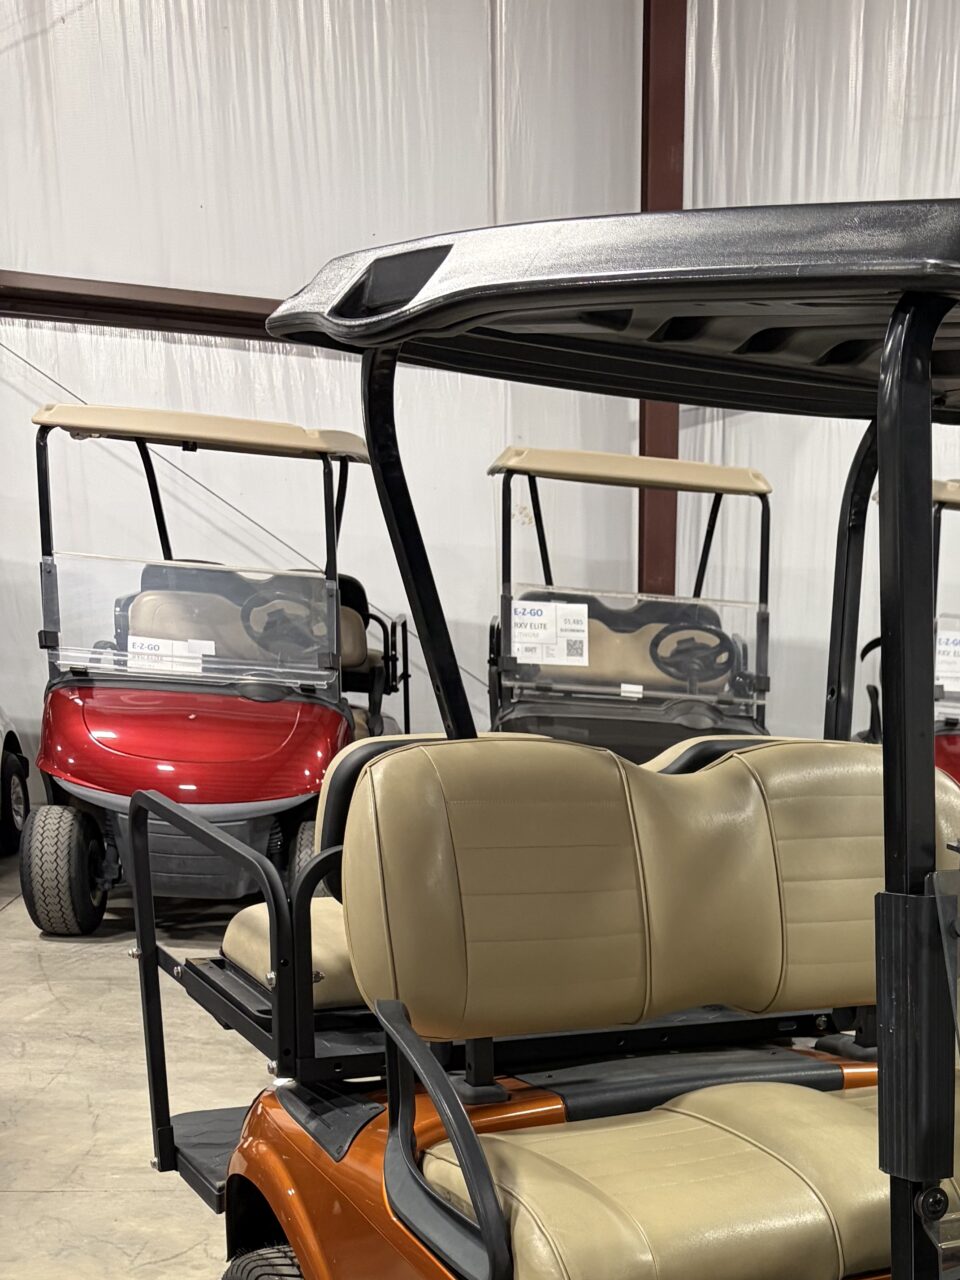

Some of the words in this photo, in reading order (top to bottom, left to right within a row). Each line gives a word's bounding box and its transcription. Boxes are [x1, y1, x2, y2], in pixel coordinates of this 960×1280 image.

[513, 607, 544, 617] E-Z-GO
[529, 622, 548, 631] ELITE
[132, 641, 161, 652] E-Z-GO
